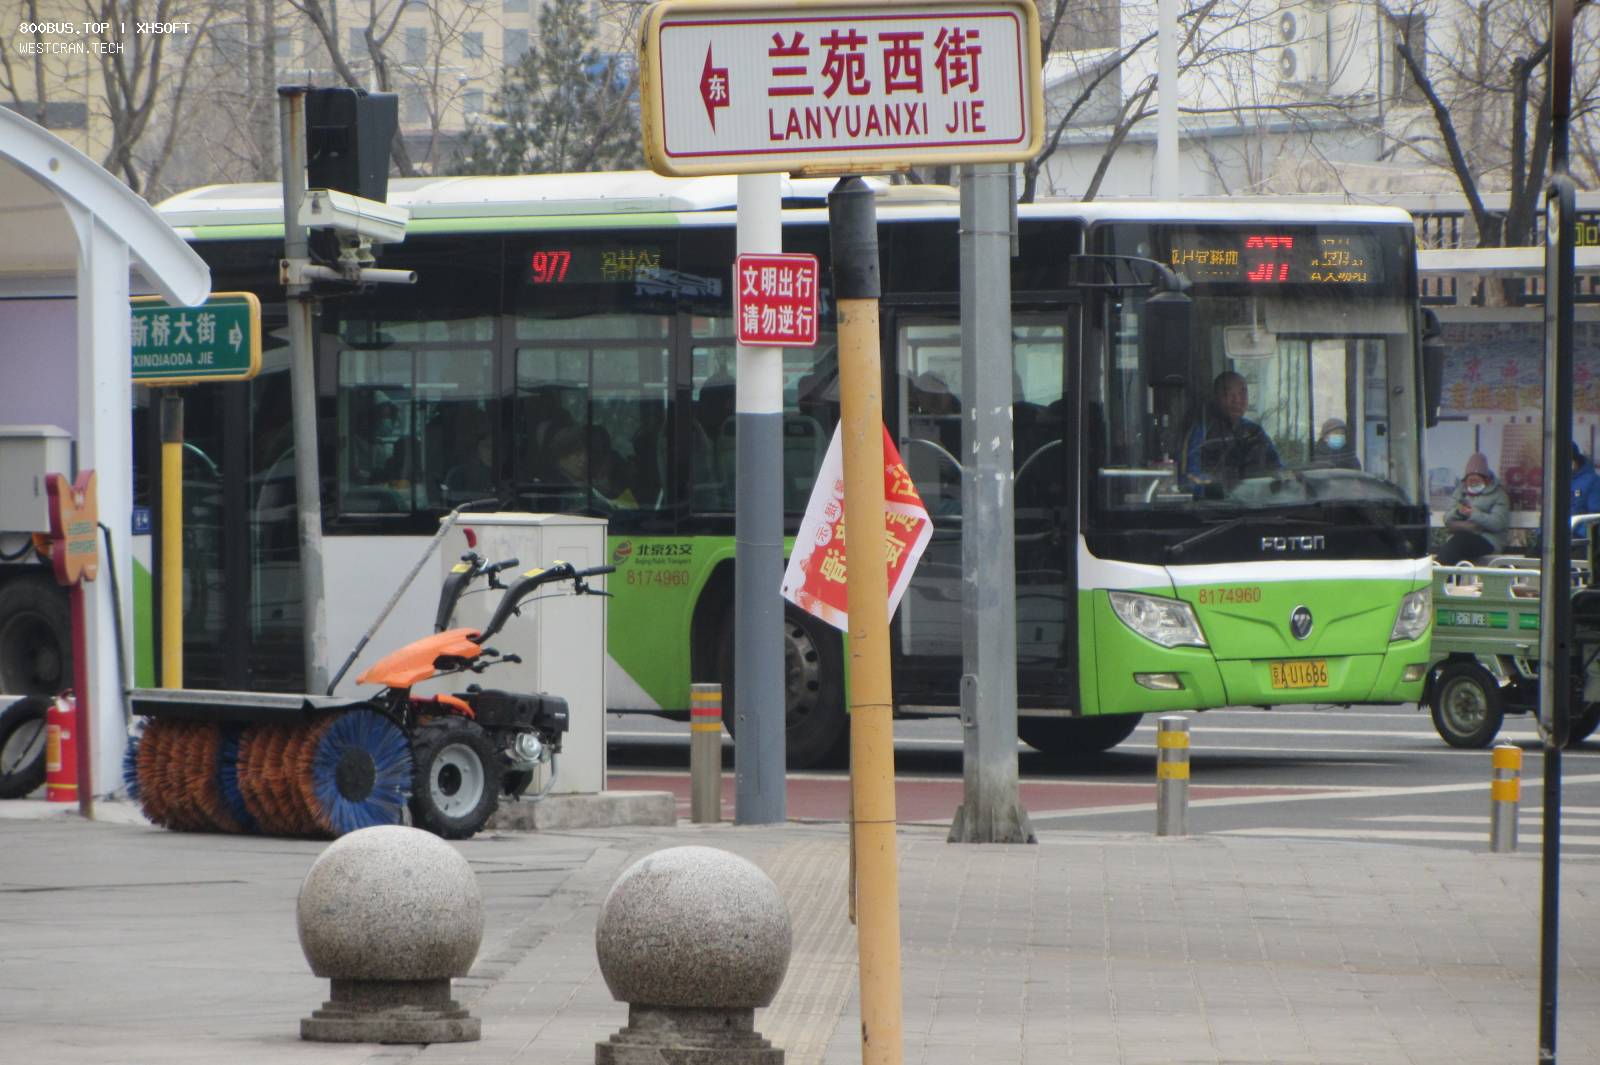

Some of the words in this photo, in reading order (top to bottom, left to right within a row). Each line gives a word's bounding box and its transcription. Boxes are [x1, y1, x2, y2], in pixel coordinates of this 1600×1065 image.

[768, 26, 983, 99] 兰苑西街
[708, 74, 728, 101] 东
[768, 102, 929, 141] LANYUANXI
[945, 100, 986, 133] JIE
[532, 251, 571, 283] 977
[743, 265, 813, 298] 文明出行
[131, 312, 216, 347] 新桥大街
[743, 303, 813, 336] 请勿逆行
[133, 352, 193, 367] XINQIAODA
[198, 351, 214, 365] JIE
[637, 544, 693, 556] 北京公交
[1261, 536, 1325, 550] FOTON
[627, 570, 689, 585] 8174960
[1199, 587, 1262, 605] 8174960
